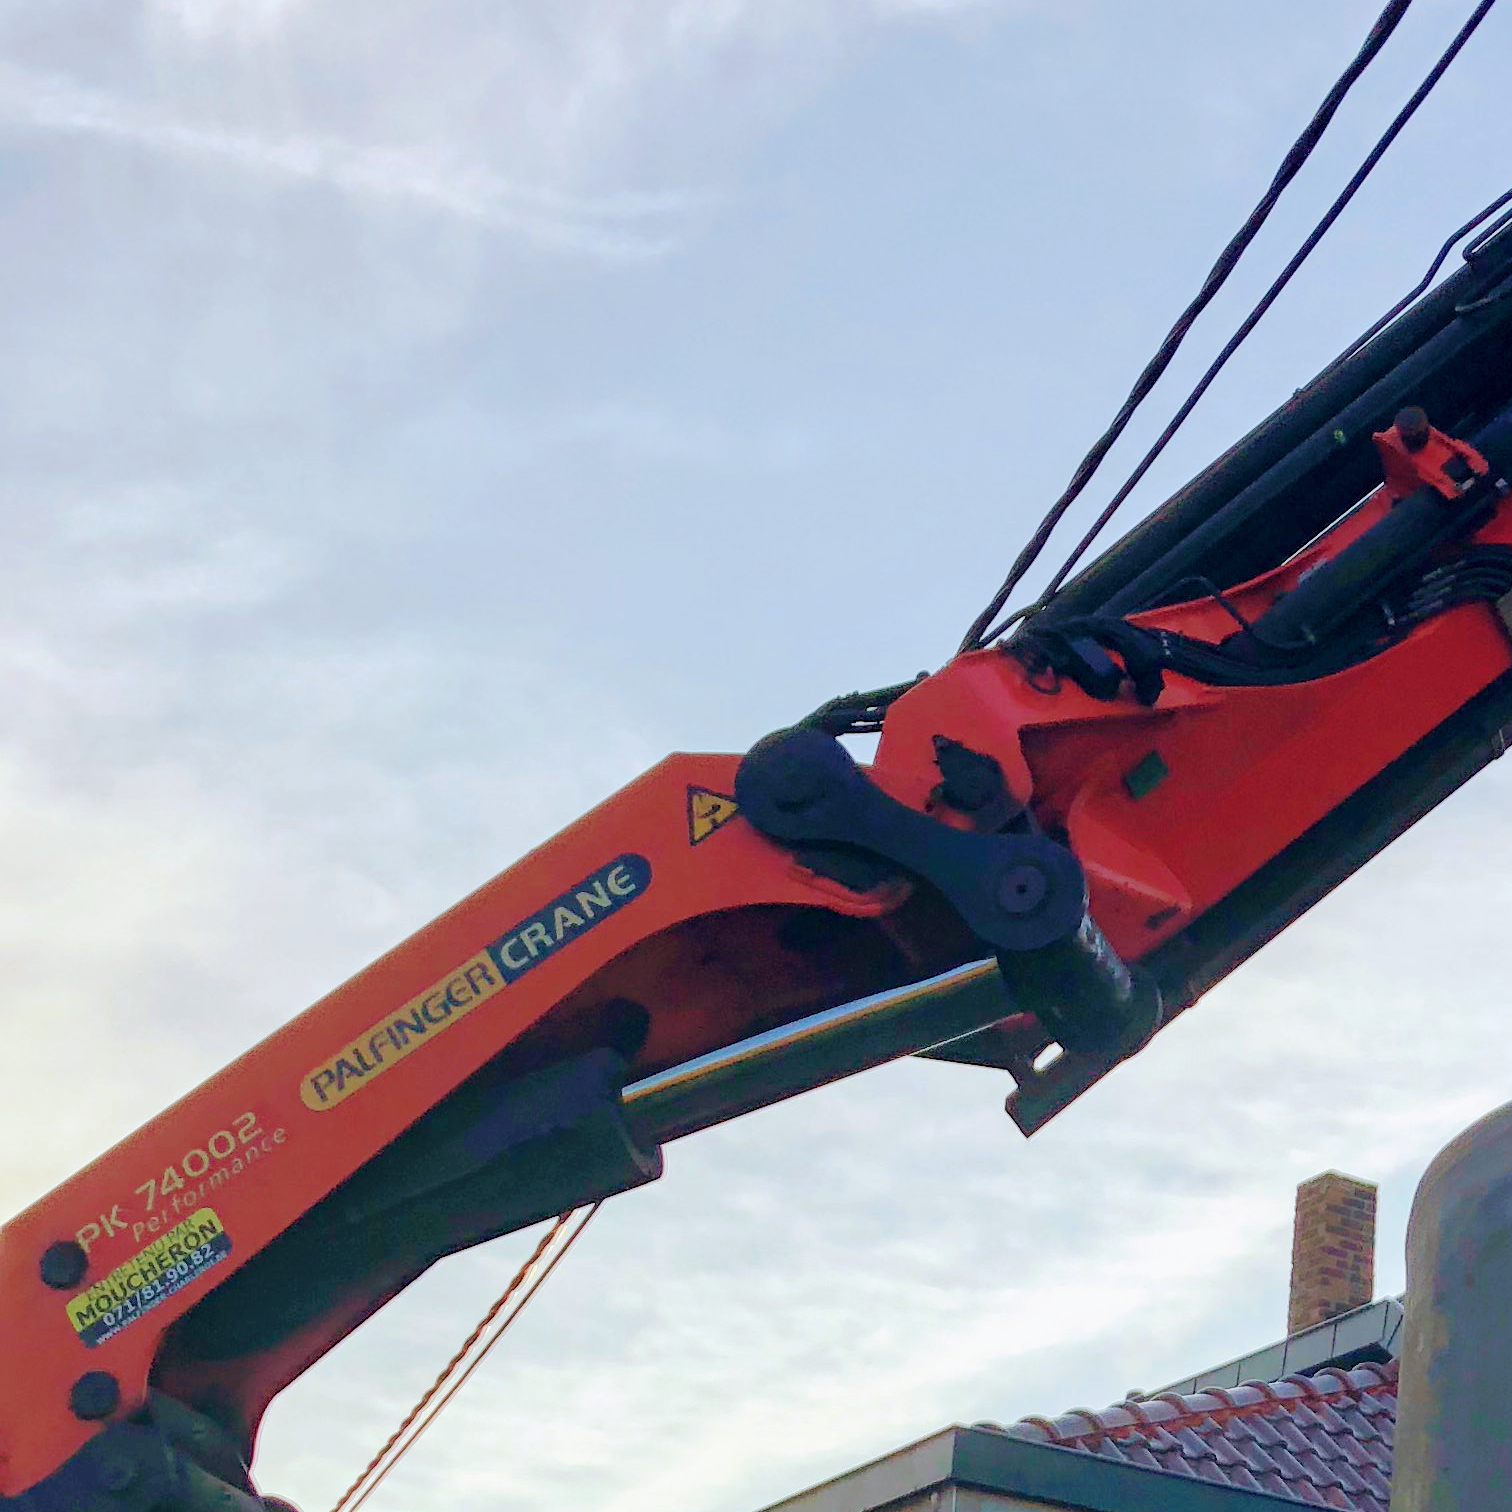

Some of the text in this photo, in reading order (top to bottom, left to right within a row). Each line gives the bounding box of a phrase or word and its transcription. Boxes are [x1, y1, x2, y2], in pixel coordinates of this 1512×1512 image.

[311, 865, 636, 1101] PALFINGER CRANE
[76, 1111, 262, 1253] PK 74002
[132, 1127, 287, 1242] Performance
[76, 1219, 217, 1326] MOUCHERON
[103, 1244, 213, 1325] 071/81.90.82
